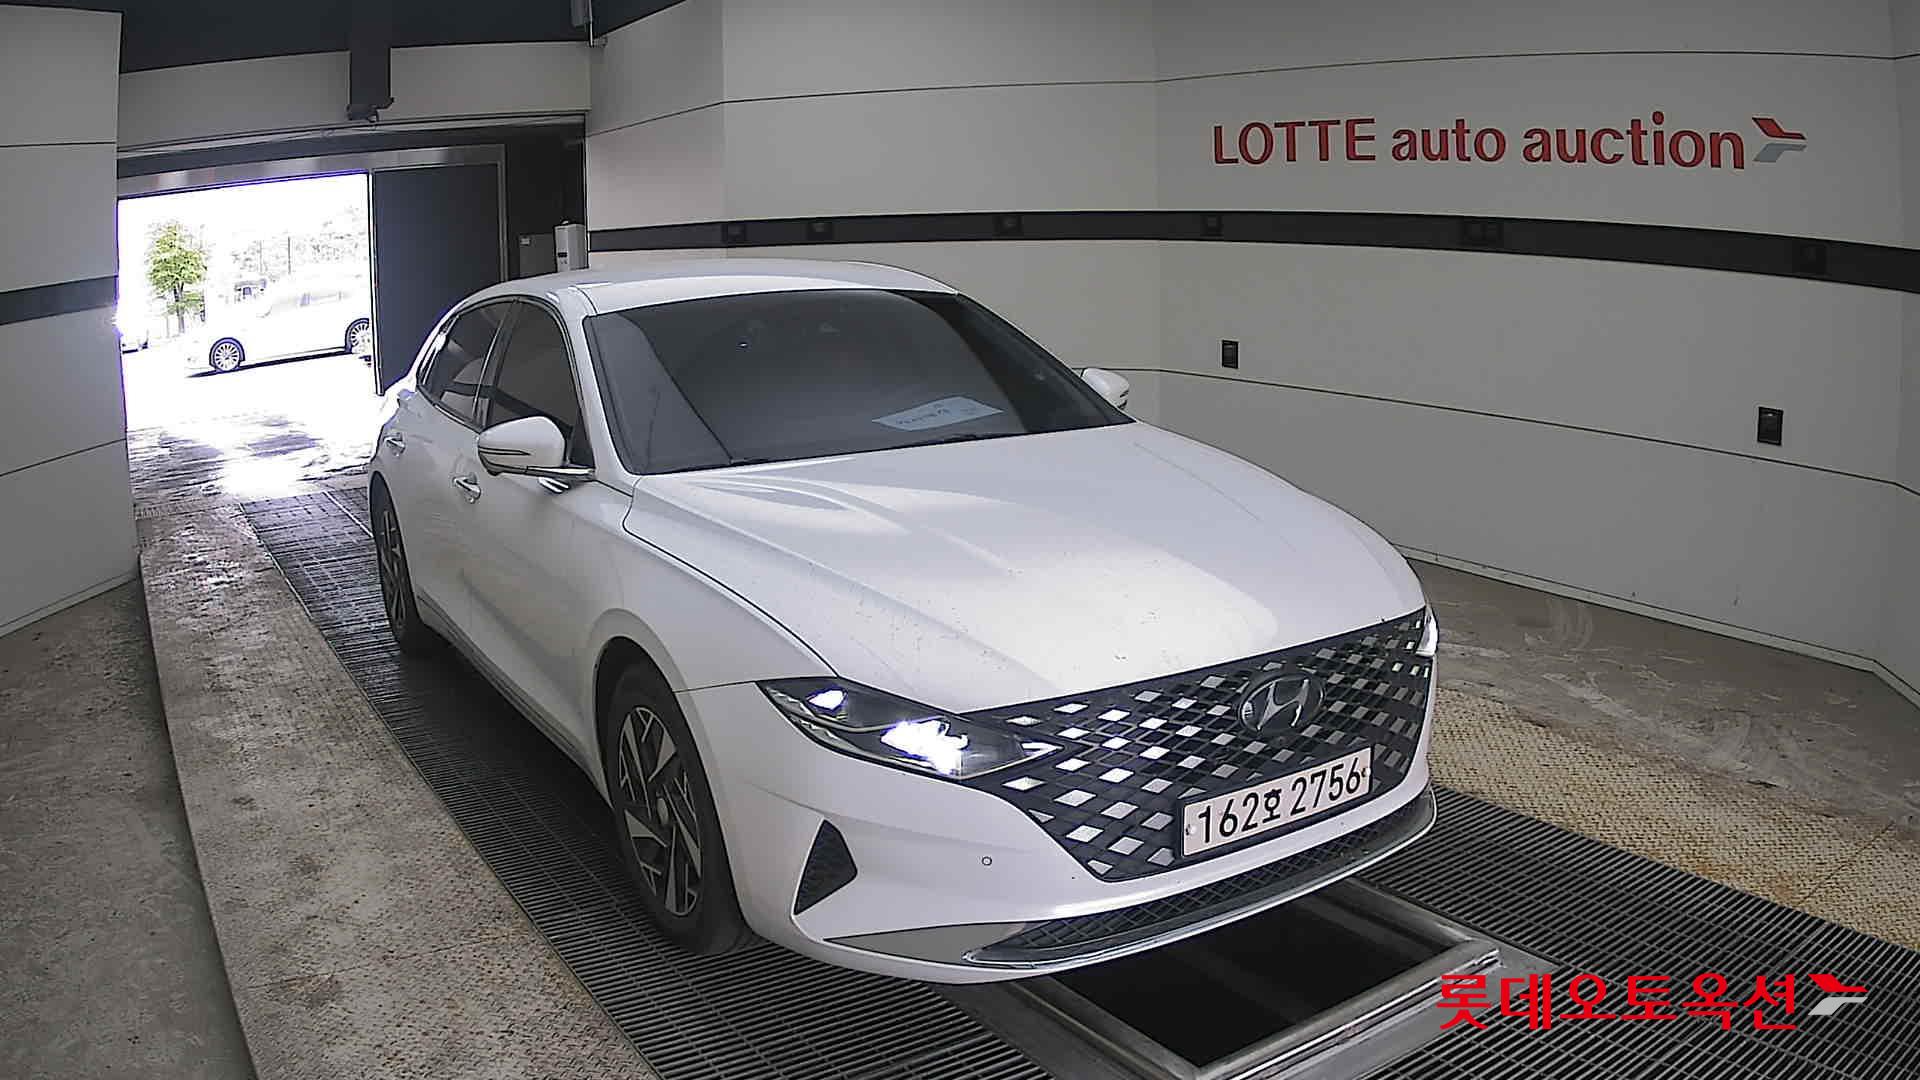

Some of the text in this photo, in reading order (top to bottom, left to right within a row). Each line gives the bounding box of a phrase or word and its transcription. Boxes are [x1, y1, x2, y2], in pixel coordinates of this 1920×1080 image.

[1213, 111, 1745, 170] LOTTE auto auction
[1290, 757, 1361, 816] 2756
